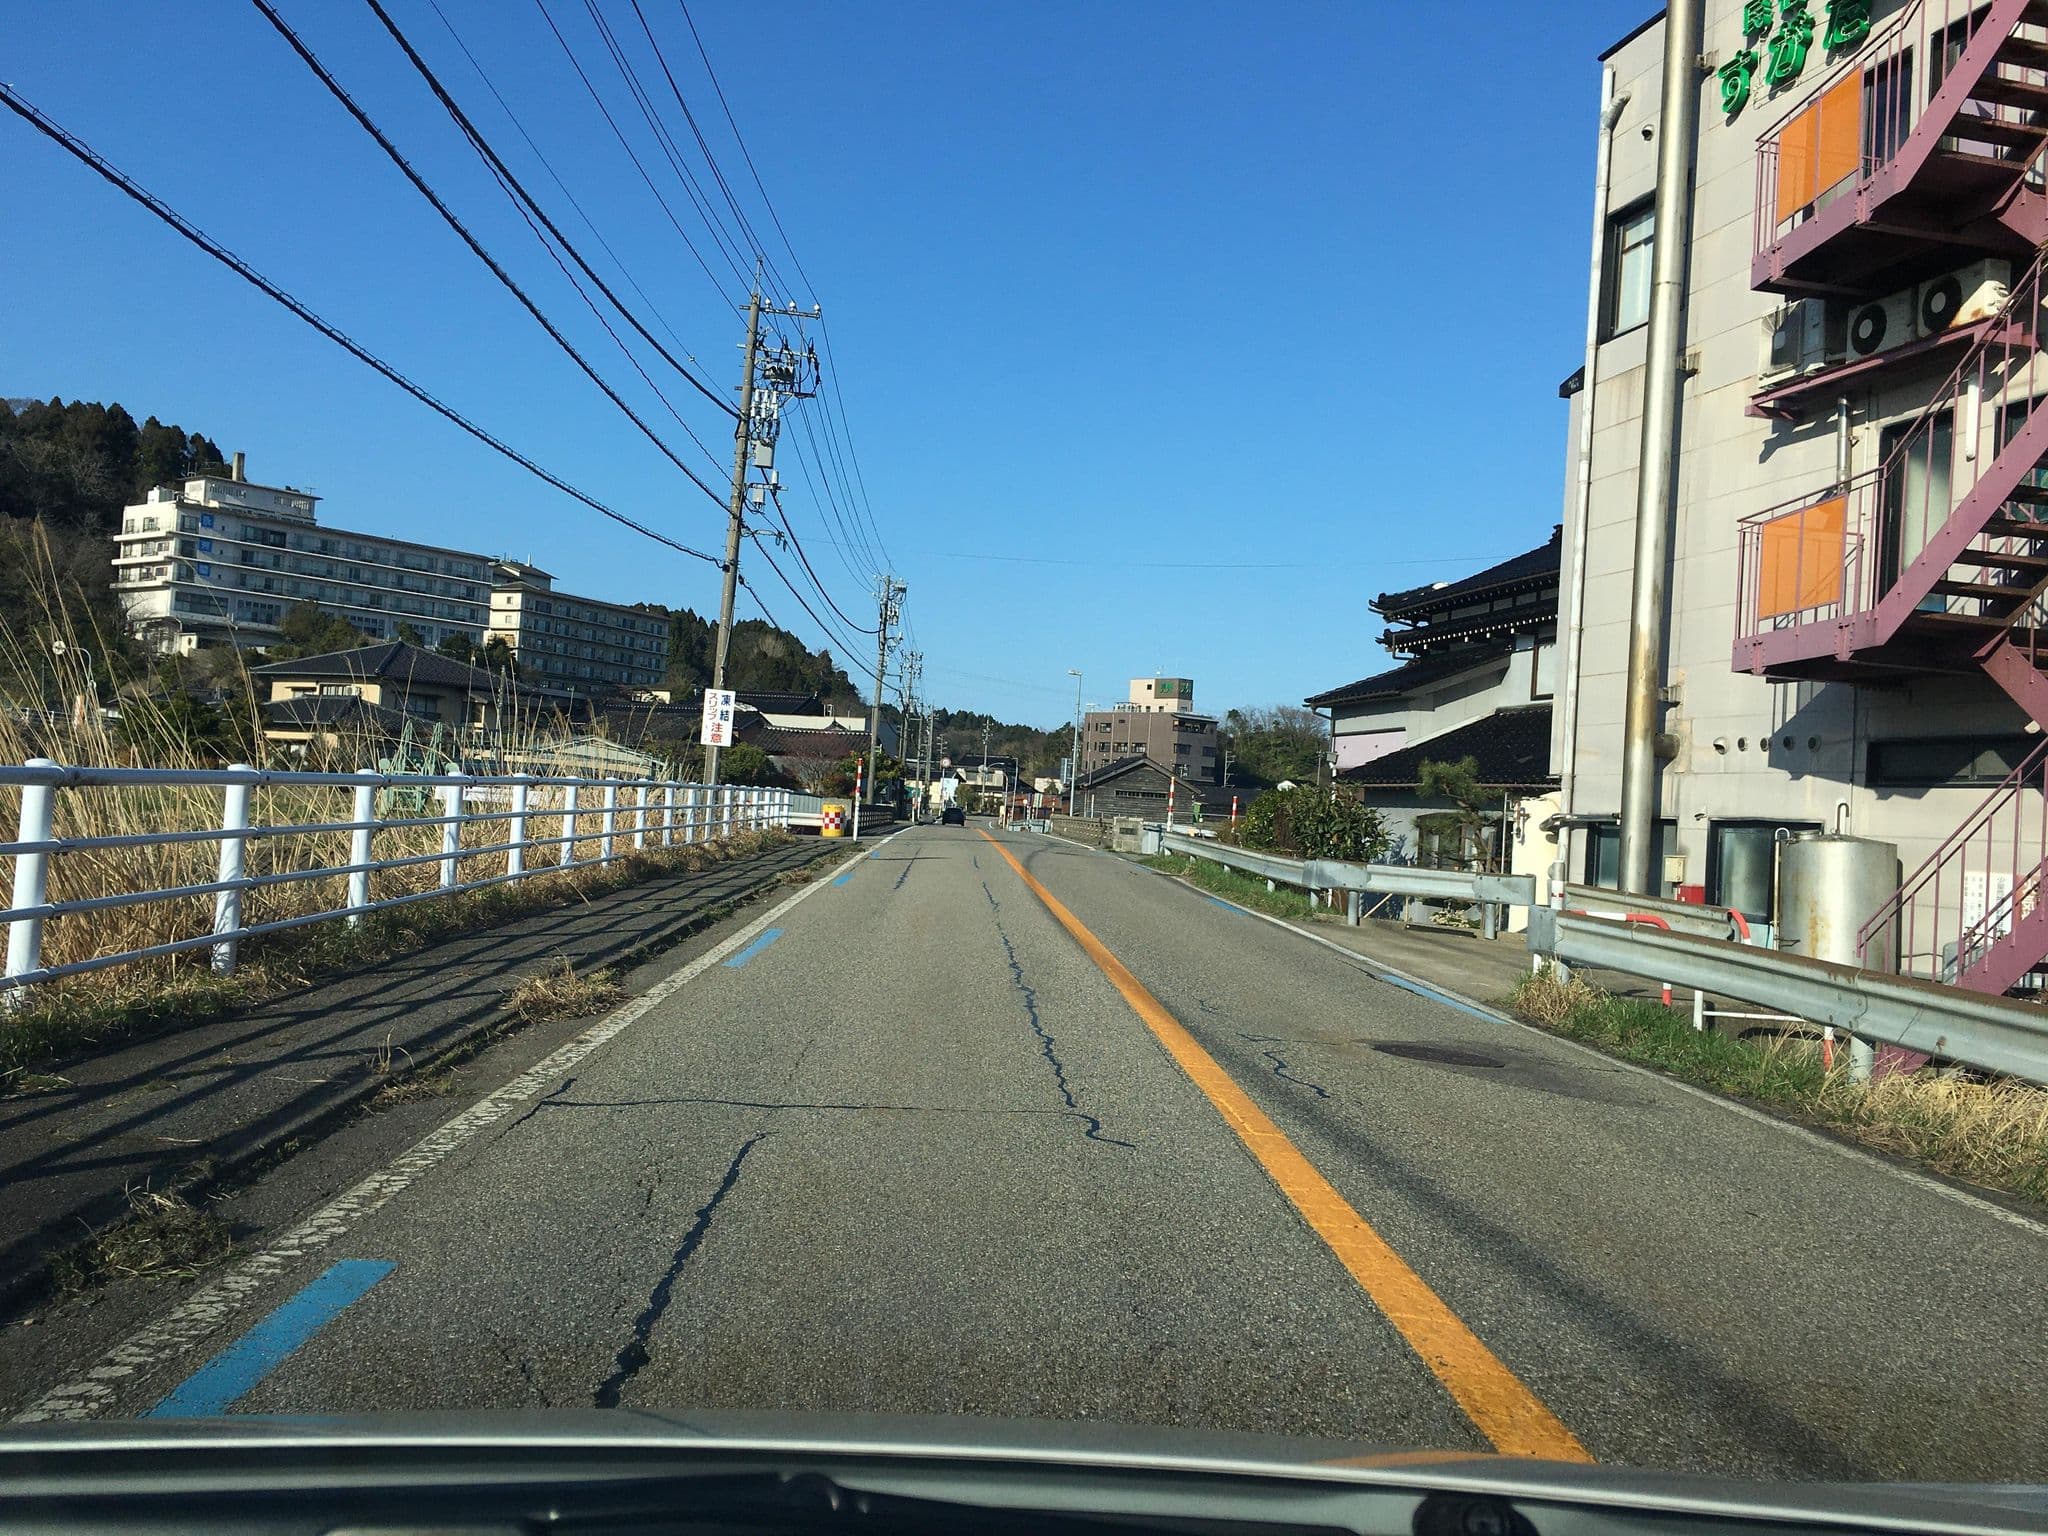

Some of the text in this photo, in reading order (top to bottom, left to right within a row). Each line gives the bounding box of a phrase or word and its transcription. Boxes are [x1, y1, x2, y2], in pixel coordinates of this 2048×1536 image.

[707, 692, 718, 720] スリップ
[720, 694, 731, 721] 凍結
[710, 722, 723, 743] 注意
